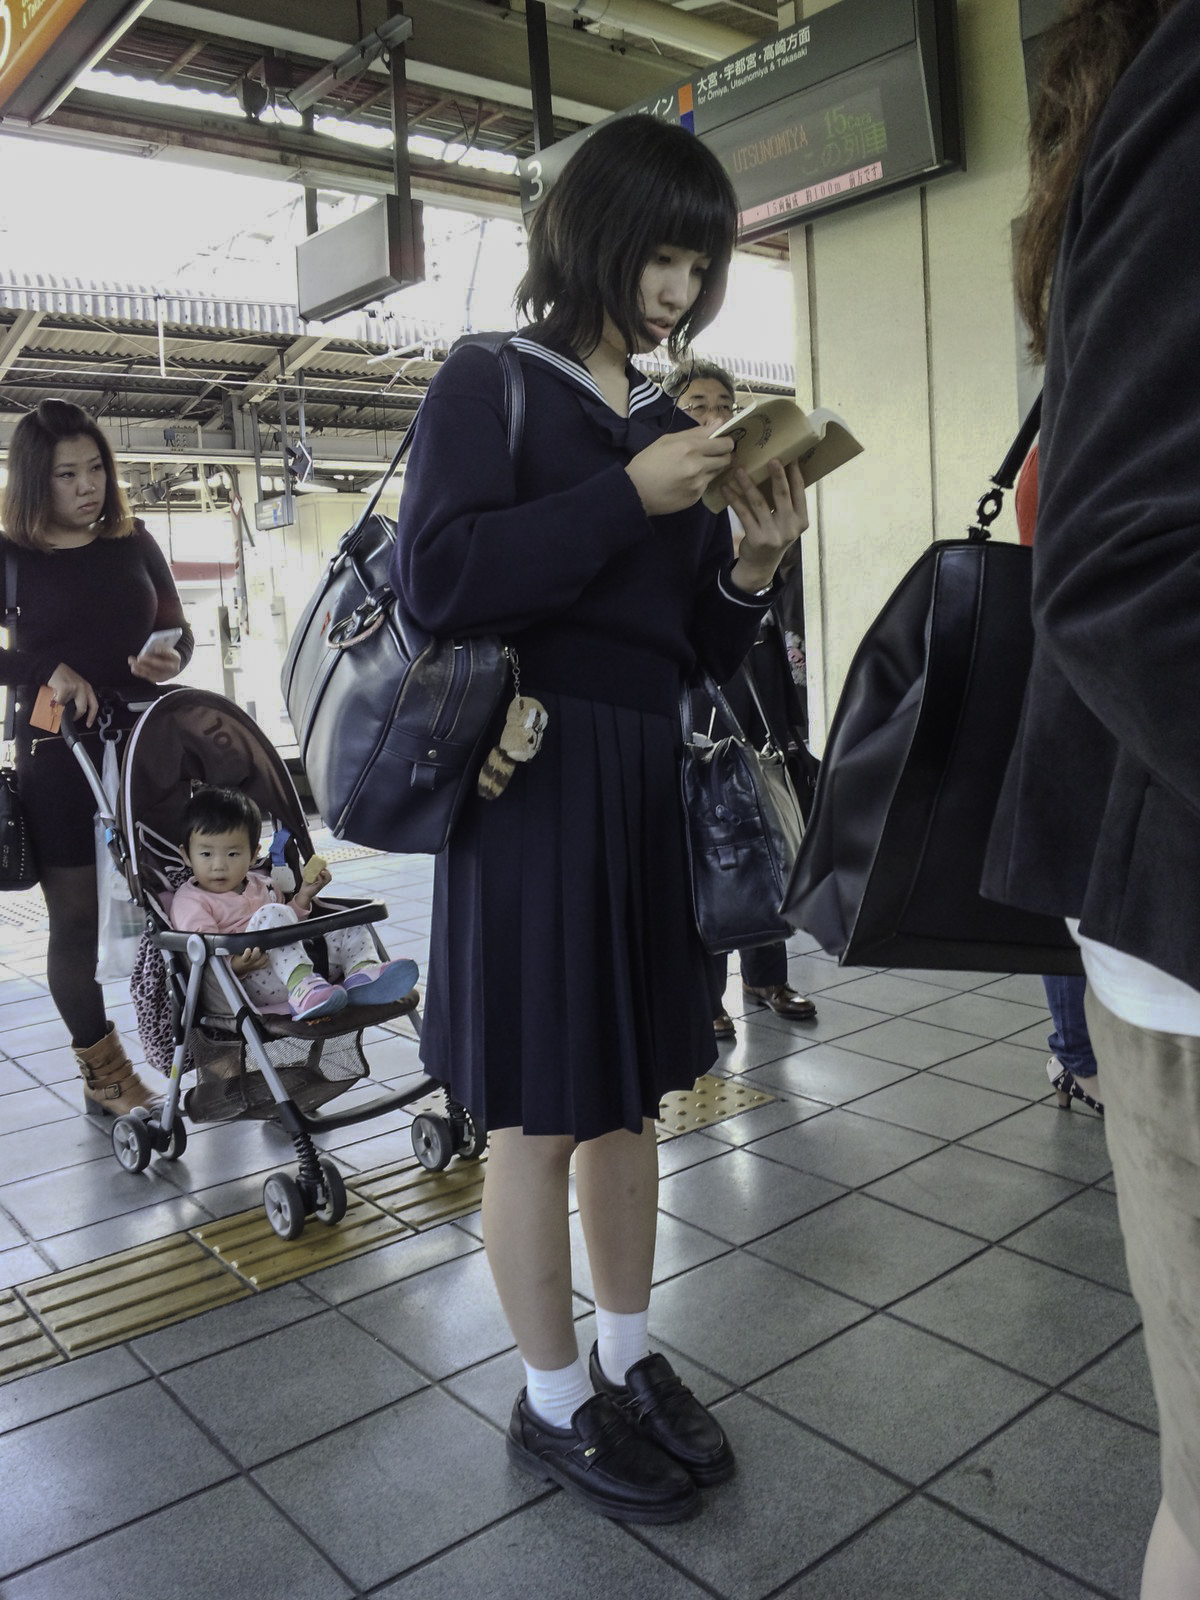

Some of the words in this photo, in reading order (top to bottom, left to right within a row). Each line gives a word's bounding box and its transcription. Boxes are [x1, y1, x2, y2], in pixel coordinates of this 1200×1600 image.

[696, 25, 811, 95] 大宮・宇都宮・高崎方面
[697, 94, 707, 105] for
[730, 67, 769, 90] Utsunomiya
[769, 62, 776, 72] &
[777, 46, 808, 67] Takasaki
[732, 124, 809, 173] UTSUNOMIYA
[802, 120, 887, 176] この列車
[527, 160, 544, 202] 3
